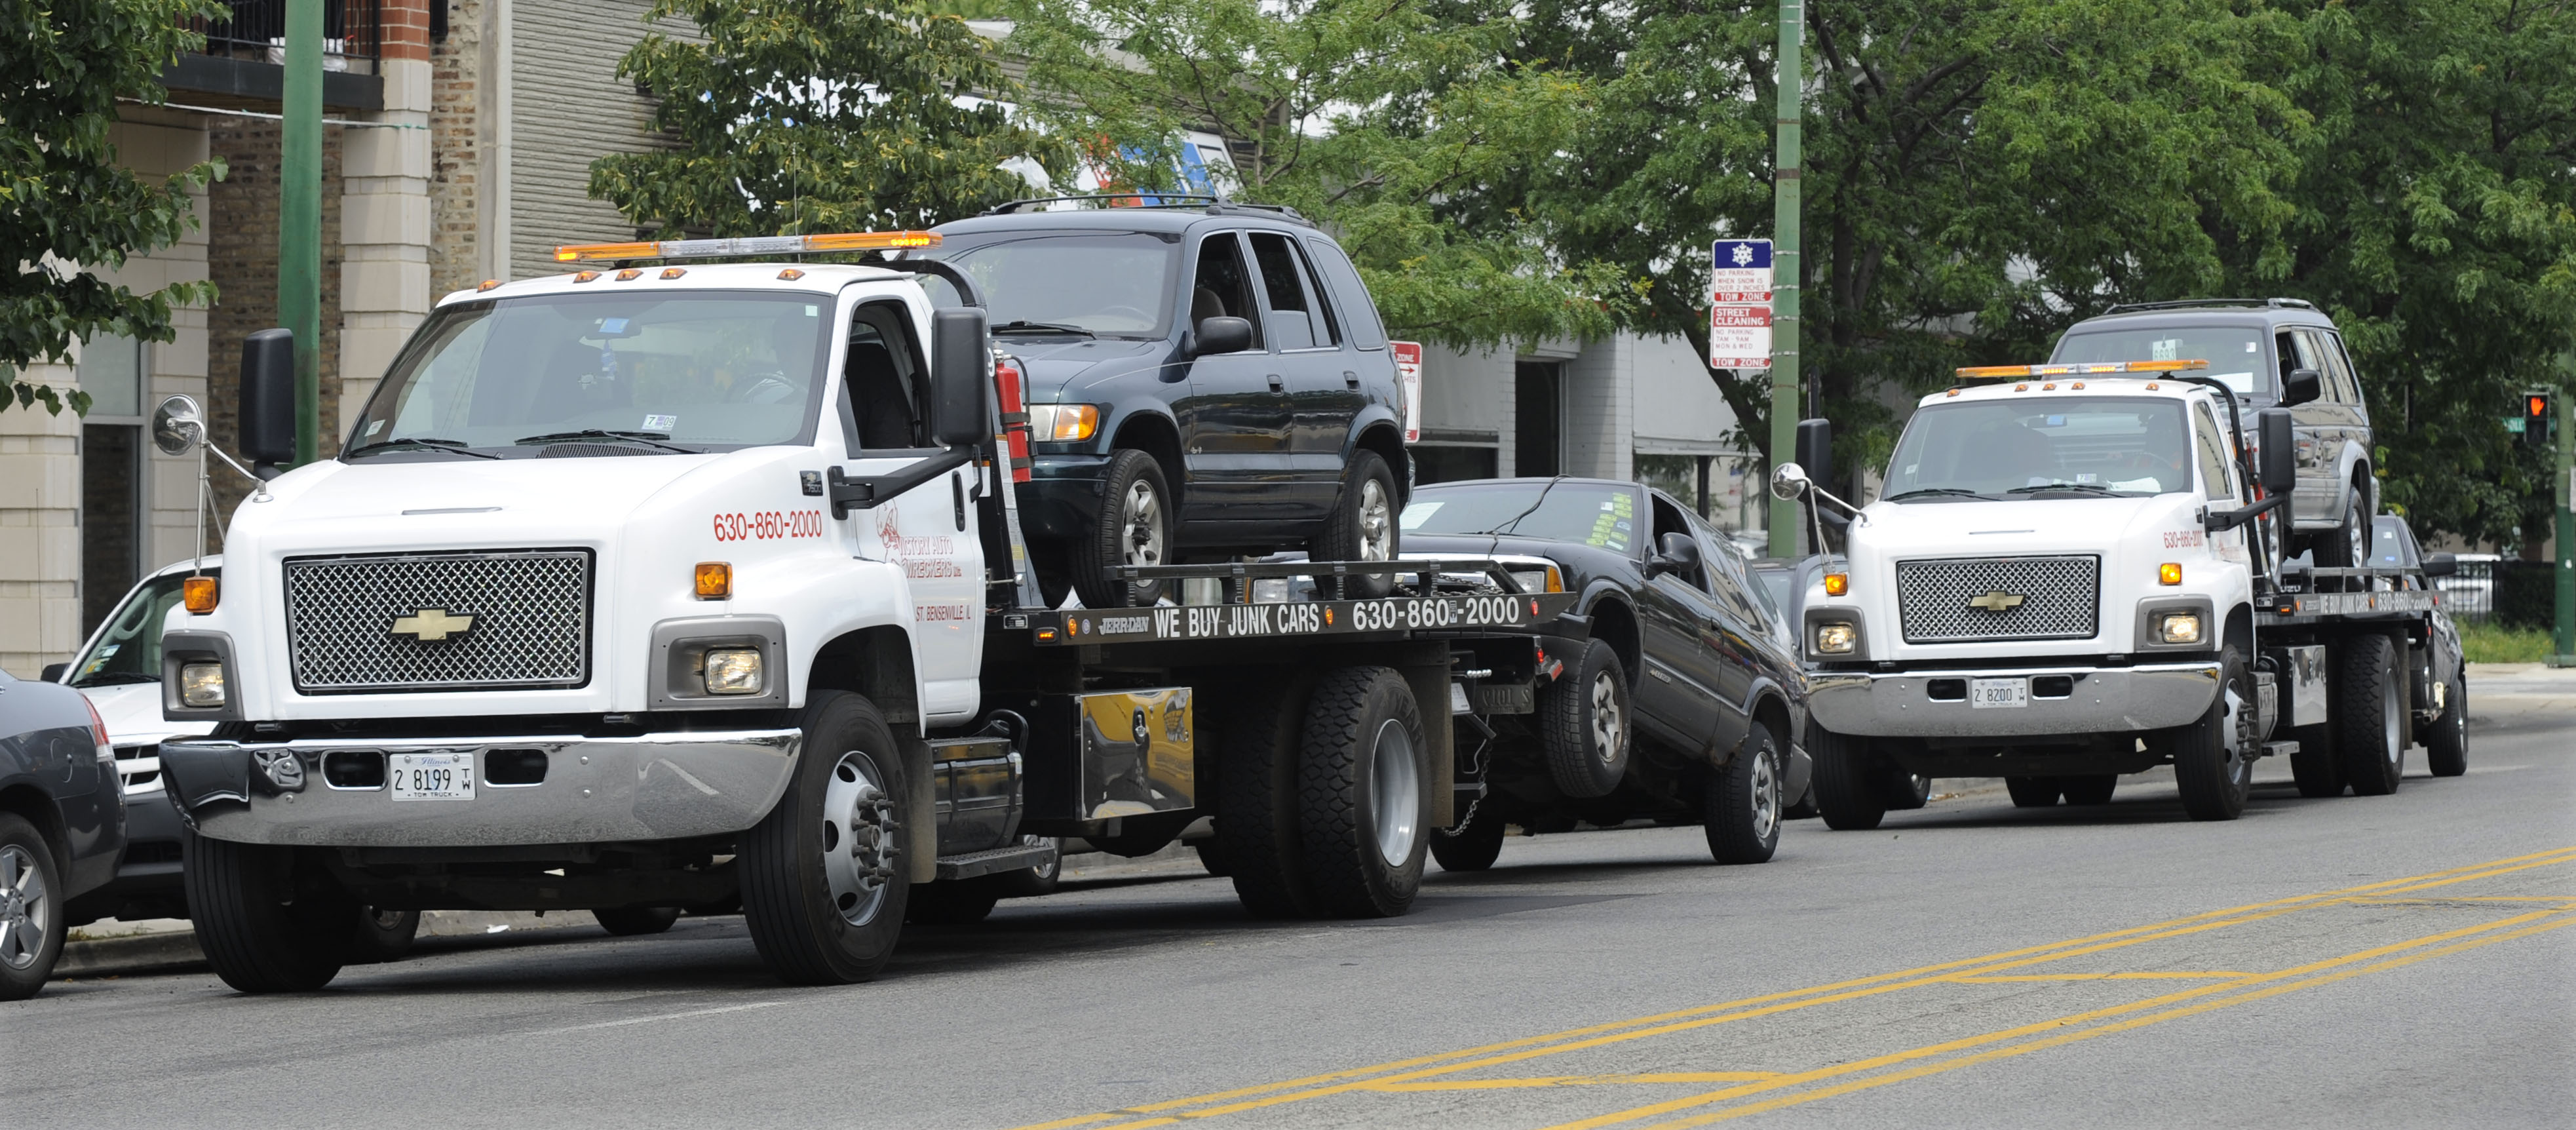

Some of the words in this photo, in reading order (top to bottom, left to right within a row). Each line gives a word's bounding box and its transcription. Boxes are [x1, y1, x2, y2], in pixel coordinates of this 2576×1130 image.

[1720, 292, 1739, 301] TOW
[1742, 292, 1765, 301] ZONE
[1716, 308, 1750, 317] STREET
[1716, 317, 1764, 326] CLEANING
[1397, 353, 1414, 362] ZONE
[649, 416, 656, 425] 7
[663, 417, 675, 426] 09
[714, 510, 822, 542] 630-860-2000
[932, 536, 953, 555] AUTO
[2320, 595, 2328, 614] WE
[2330, 594, 2340, 614] BUY
[2341, 595, 2355, 614] JUNK
[2355, 593, 2369, 612] CARS
[1154, 609, 1180, 638] WE
[1188, 607, 1221, 637] BUY
[1227, 606, 1271, 636] JUNK
[1277, 603, 1319, 634] CARS
[1353, 596, 1520, 631] 630-860-2000
[1974, 688, 1981, 702] 2
[1987, 688, 2012, 702] 8200
[394, 769, 404, 790] 2
[413, 768, 452, 790] 8199
